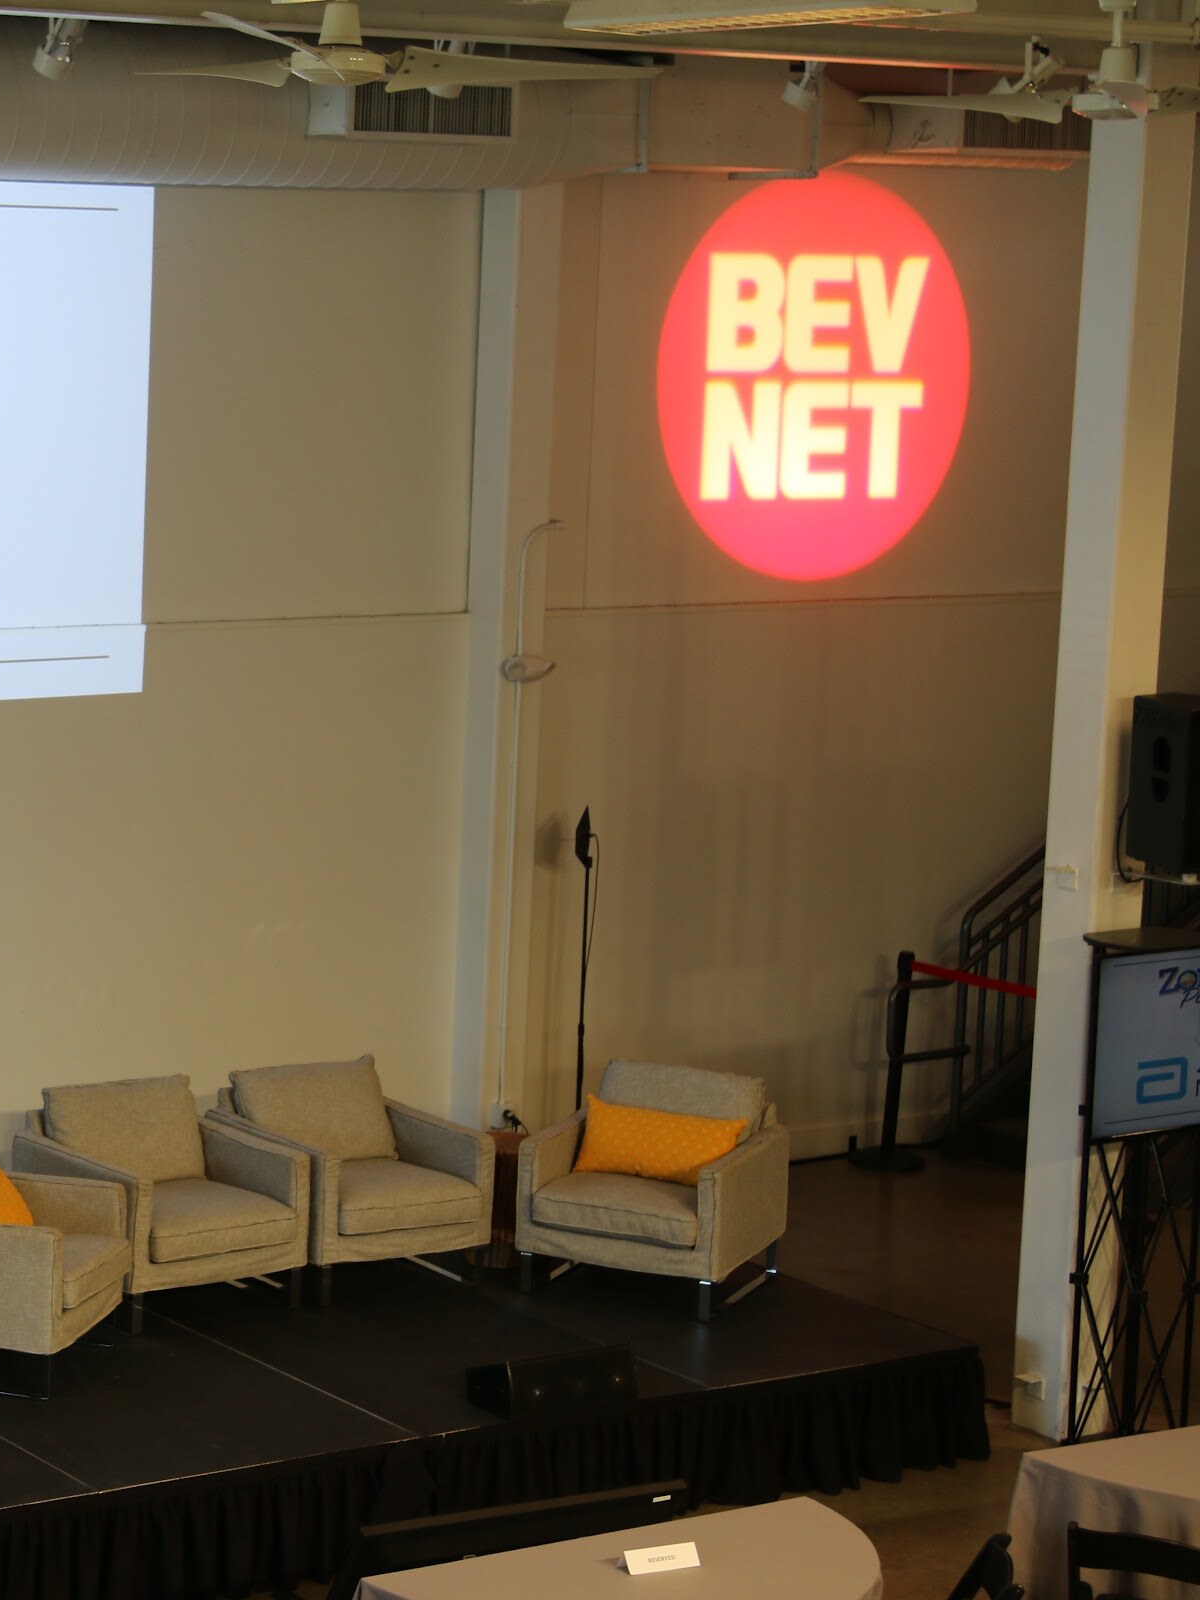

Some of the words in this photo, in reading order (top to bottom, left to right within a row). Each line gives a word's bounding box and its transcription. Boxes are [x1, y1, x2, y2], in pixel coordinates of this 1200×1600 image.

[706, 252, 931, 373] BEV
[700, 379, 924, 501] NET
[648, 1554, 676, 1563] RESERVED
